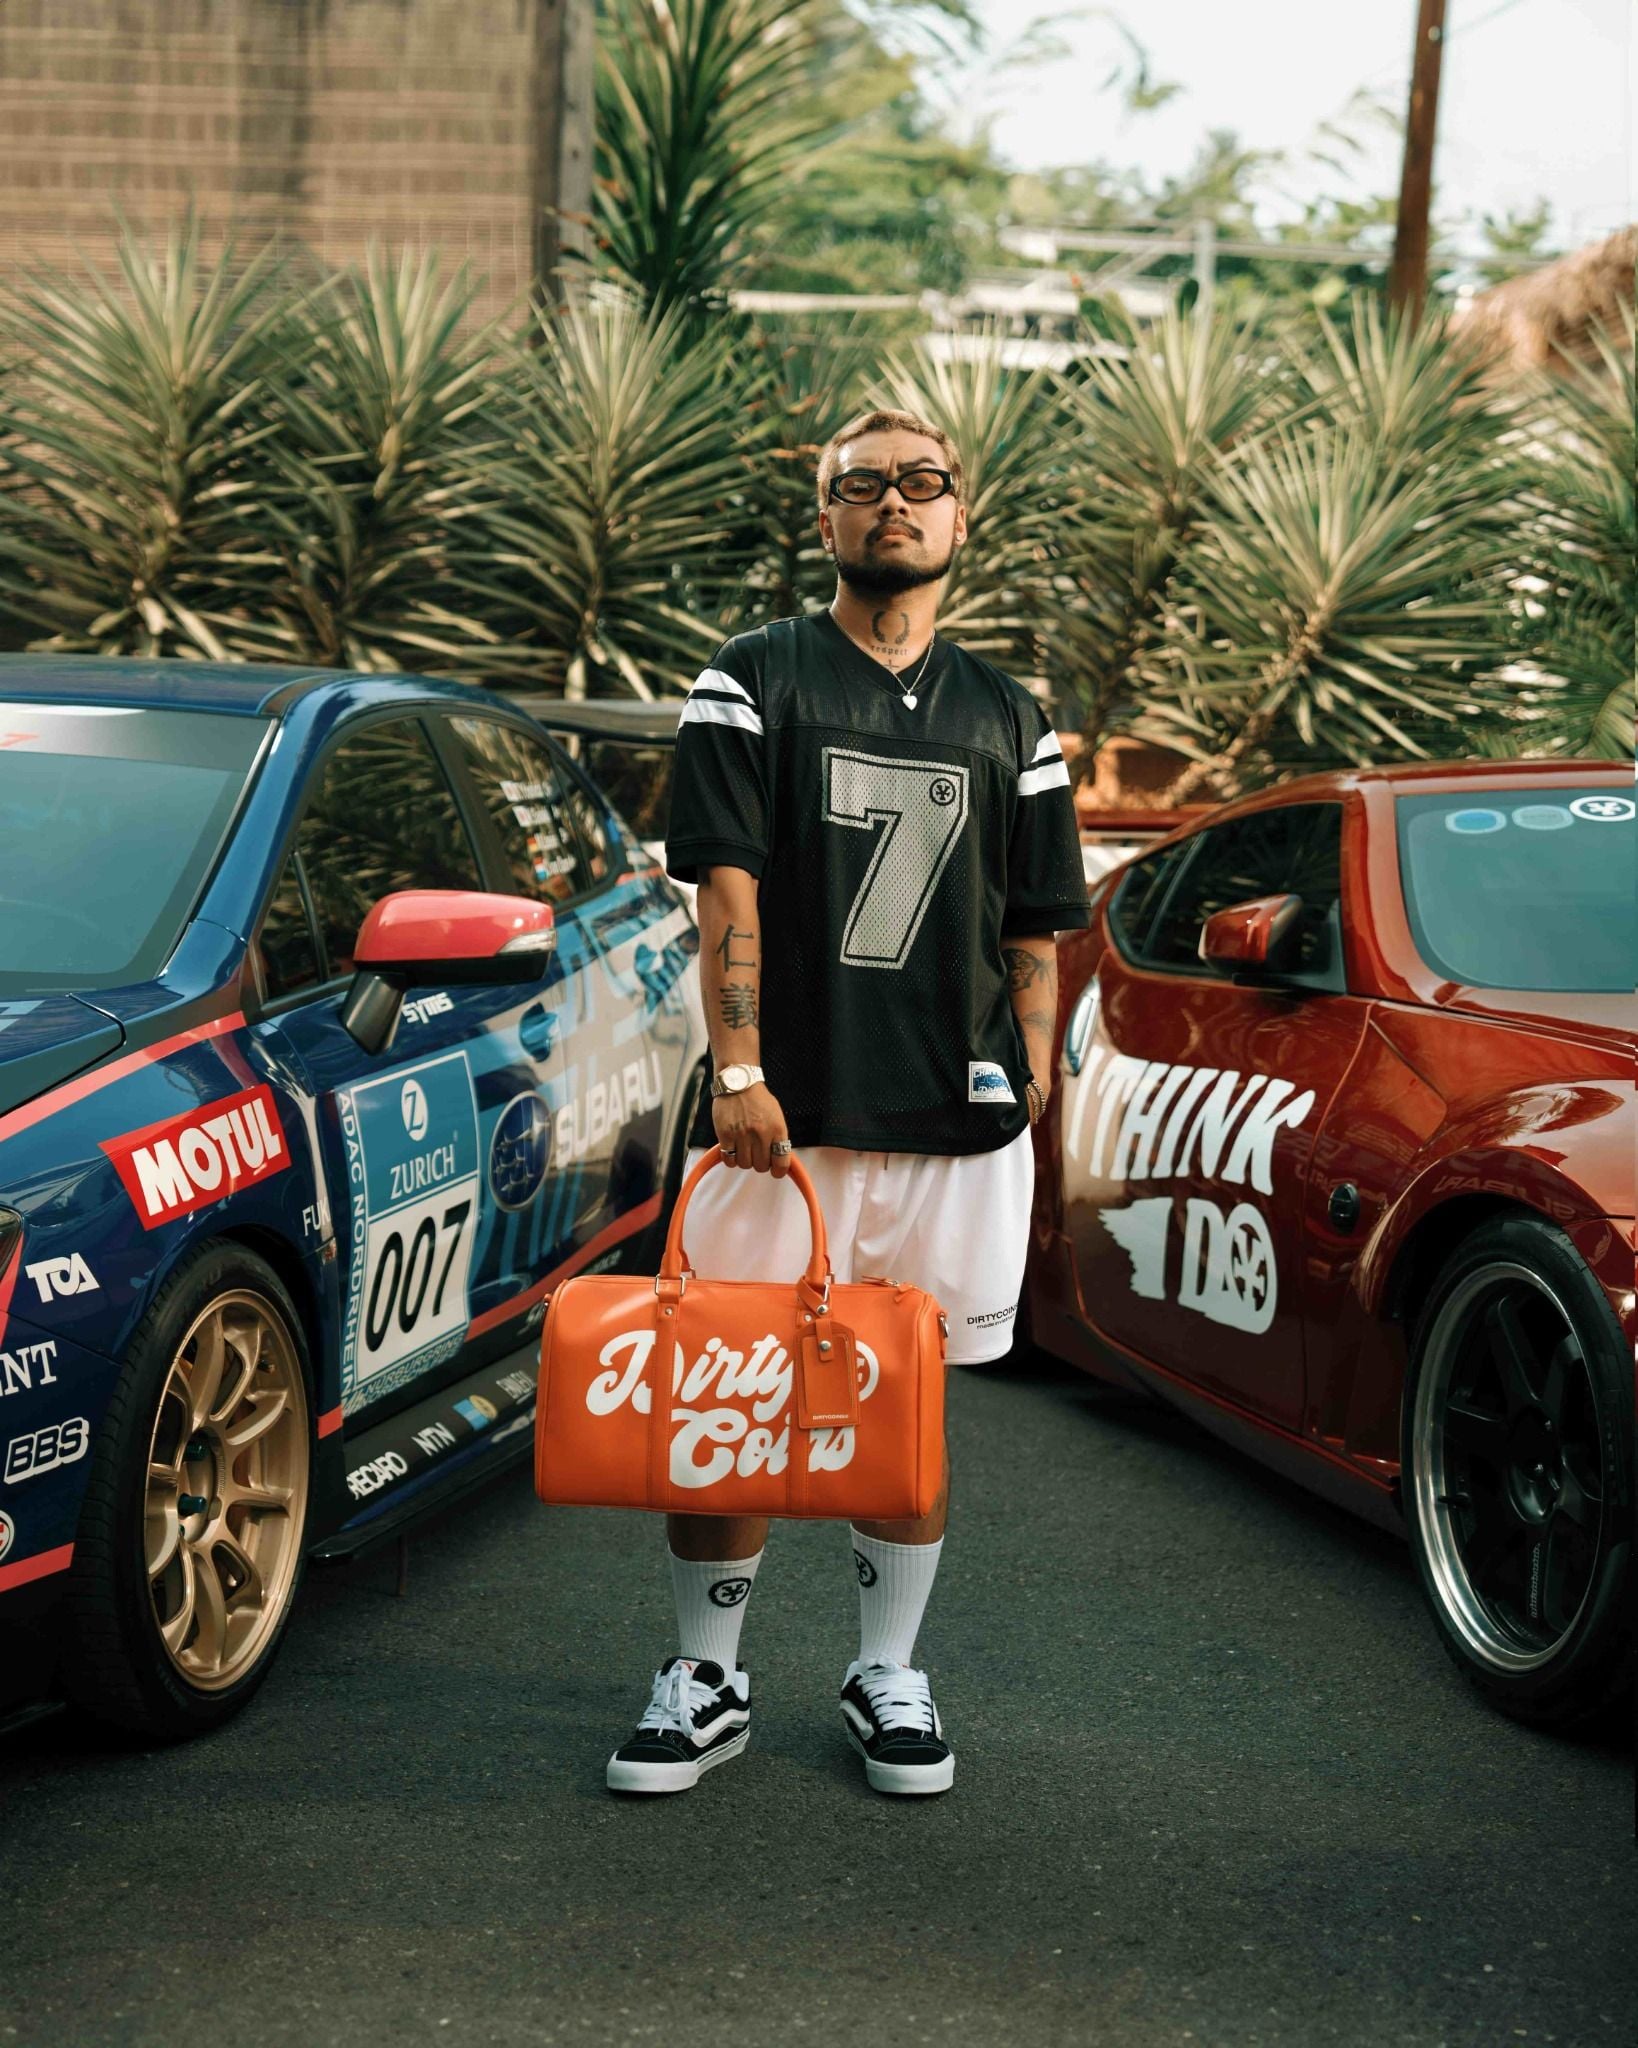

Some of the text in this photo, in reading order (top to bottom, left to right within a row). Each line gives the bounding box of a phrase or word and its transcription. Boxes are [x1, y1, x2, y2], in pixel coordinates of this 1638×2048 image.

[822, 747, 969, 970] 7
[555, 1050, 663, 1169] SUBARU
[1089, 1053, 1316, 1197] THINK
[131, 1097, 282, 1216] MOTUL
[390, 1143, 455, 1200] ZURICH
[26, 1252, 100, 1302] TOA
[338, 1092, 365, 1398] ADAC NORDRHEIN
[366, 1199, 472, 1352] 007
[0, 1340, 58, 1397] NT
[586, 1330, 794, 1422] Dirty
[4, 1417, 89, 1484] BBS
[346, 1451, 408, 1500] RECARO
[412, 1422, 455, 1456] NTN
